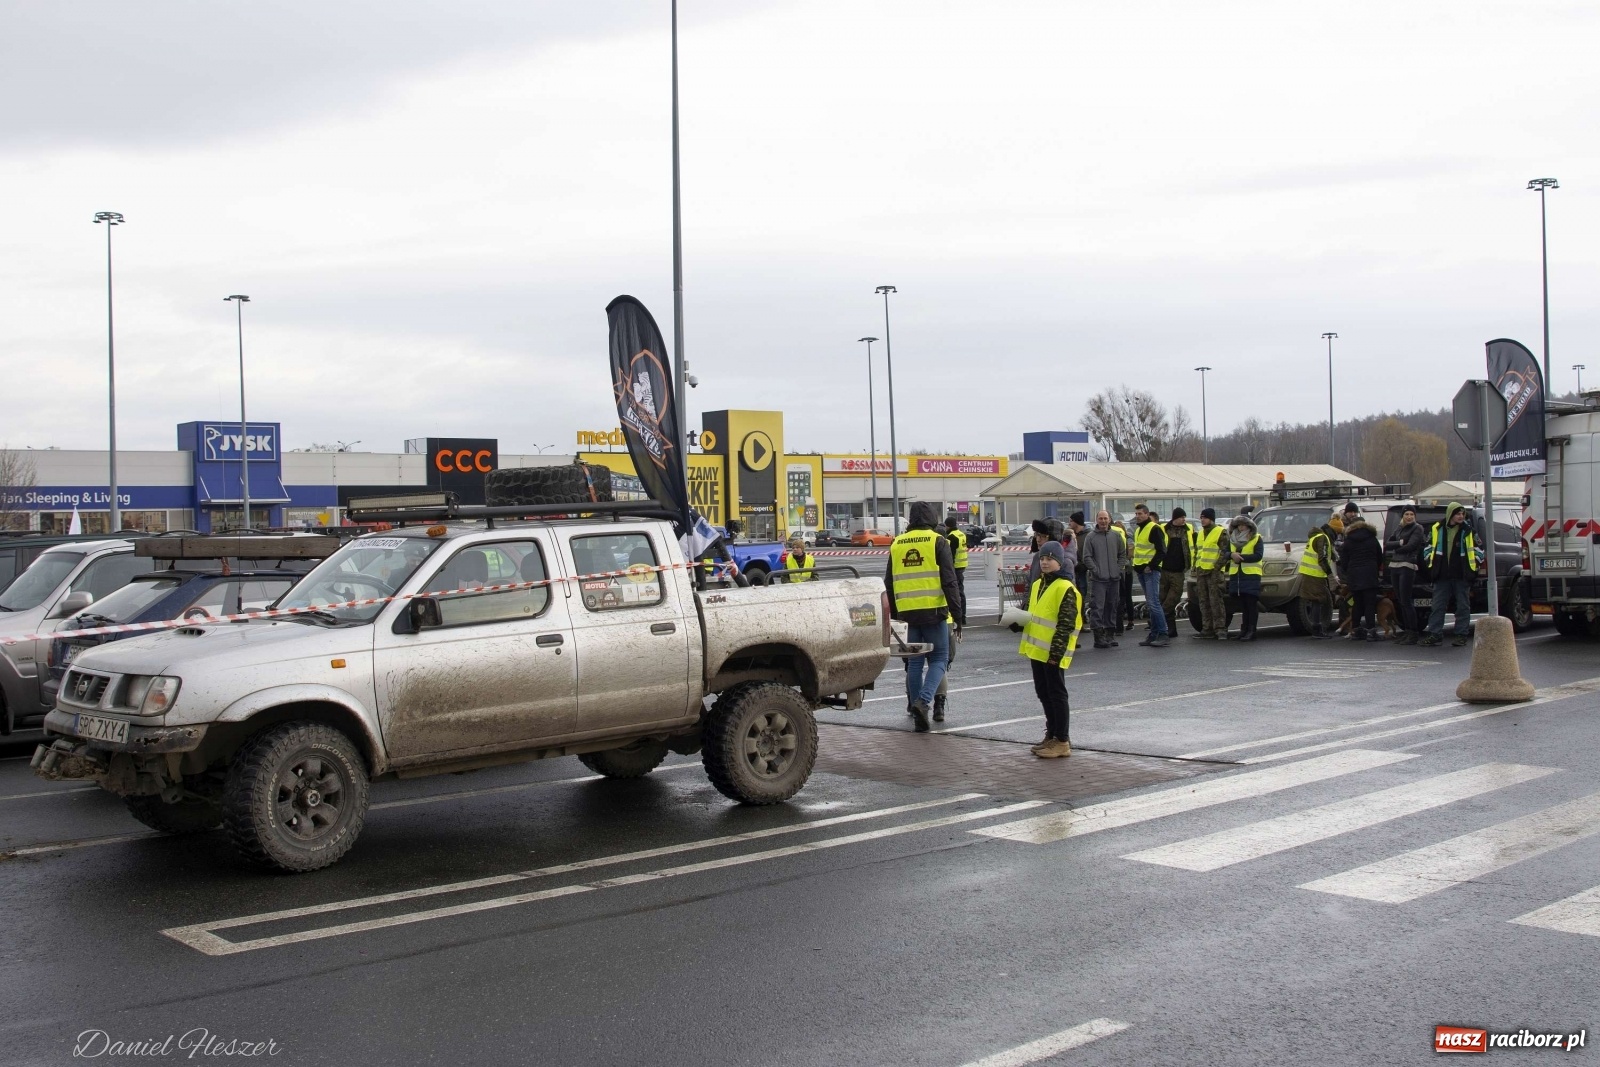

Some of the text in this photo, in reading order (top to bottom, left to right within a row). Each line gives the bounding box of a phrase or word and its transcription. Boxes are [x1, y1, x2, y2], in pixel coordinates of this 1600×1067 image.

[220, 434, 272, 452] JYSK
[435, 449, 492, 473] CCC
[1060, 451, 1088, 462] ACTION
[841, 459, 893, 470] ROSSMANN
[921, 460, 953, 473] CHINA
[688, 466, 719, 481] ZAMY
[1, 492, 131, 506] ian Sleeping & Livng
[688, 481, 719, 505] KIE
[739, 505, 769, 513] mediaexpert
[584, 582, 607, 590] MOTUL
[705, 595, 727, 604] KTM
[78, 714, 126, 744] SRC 7XY4
[311, 743, 357, 784] DISCOVERER
[267, 772, 278, 828] COOPER
